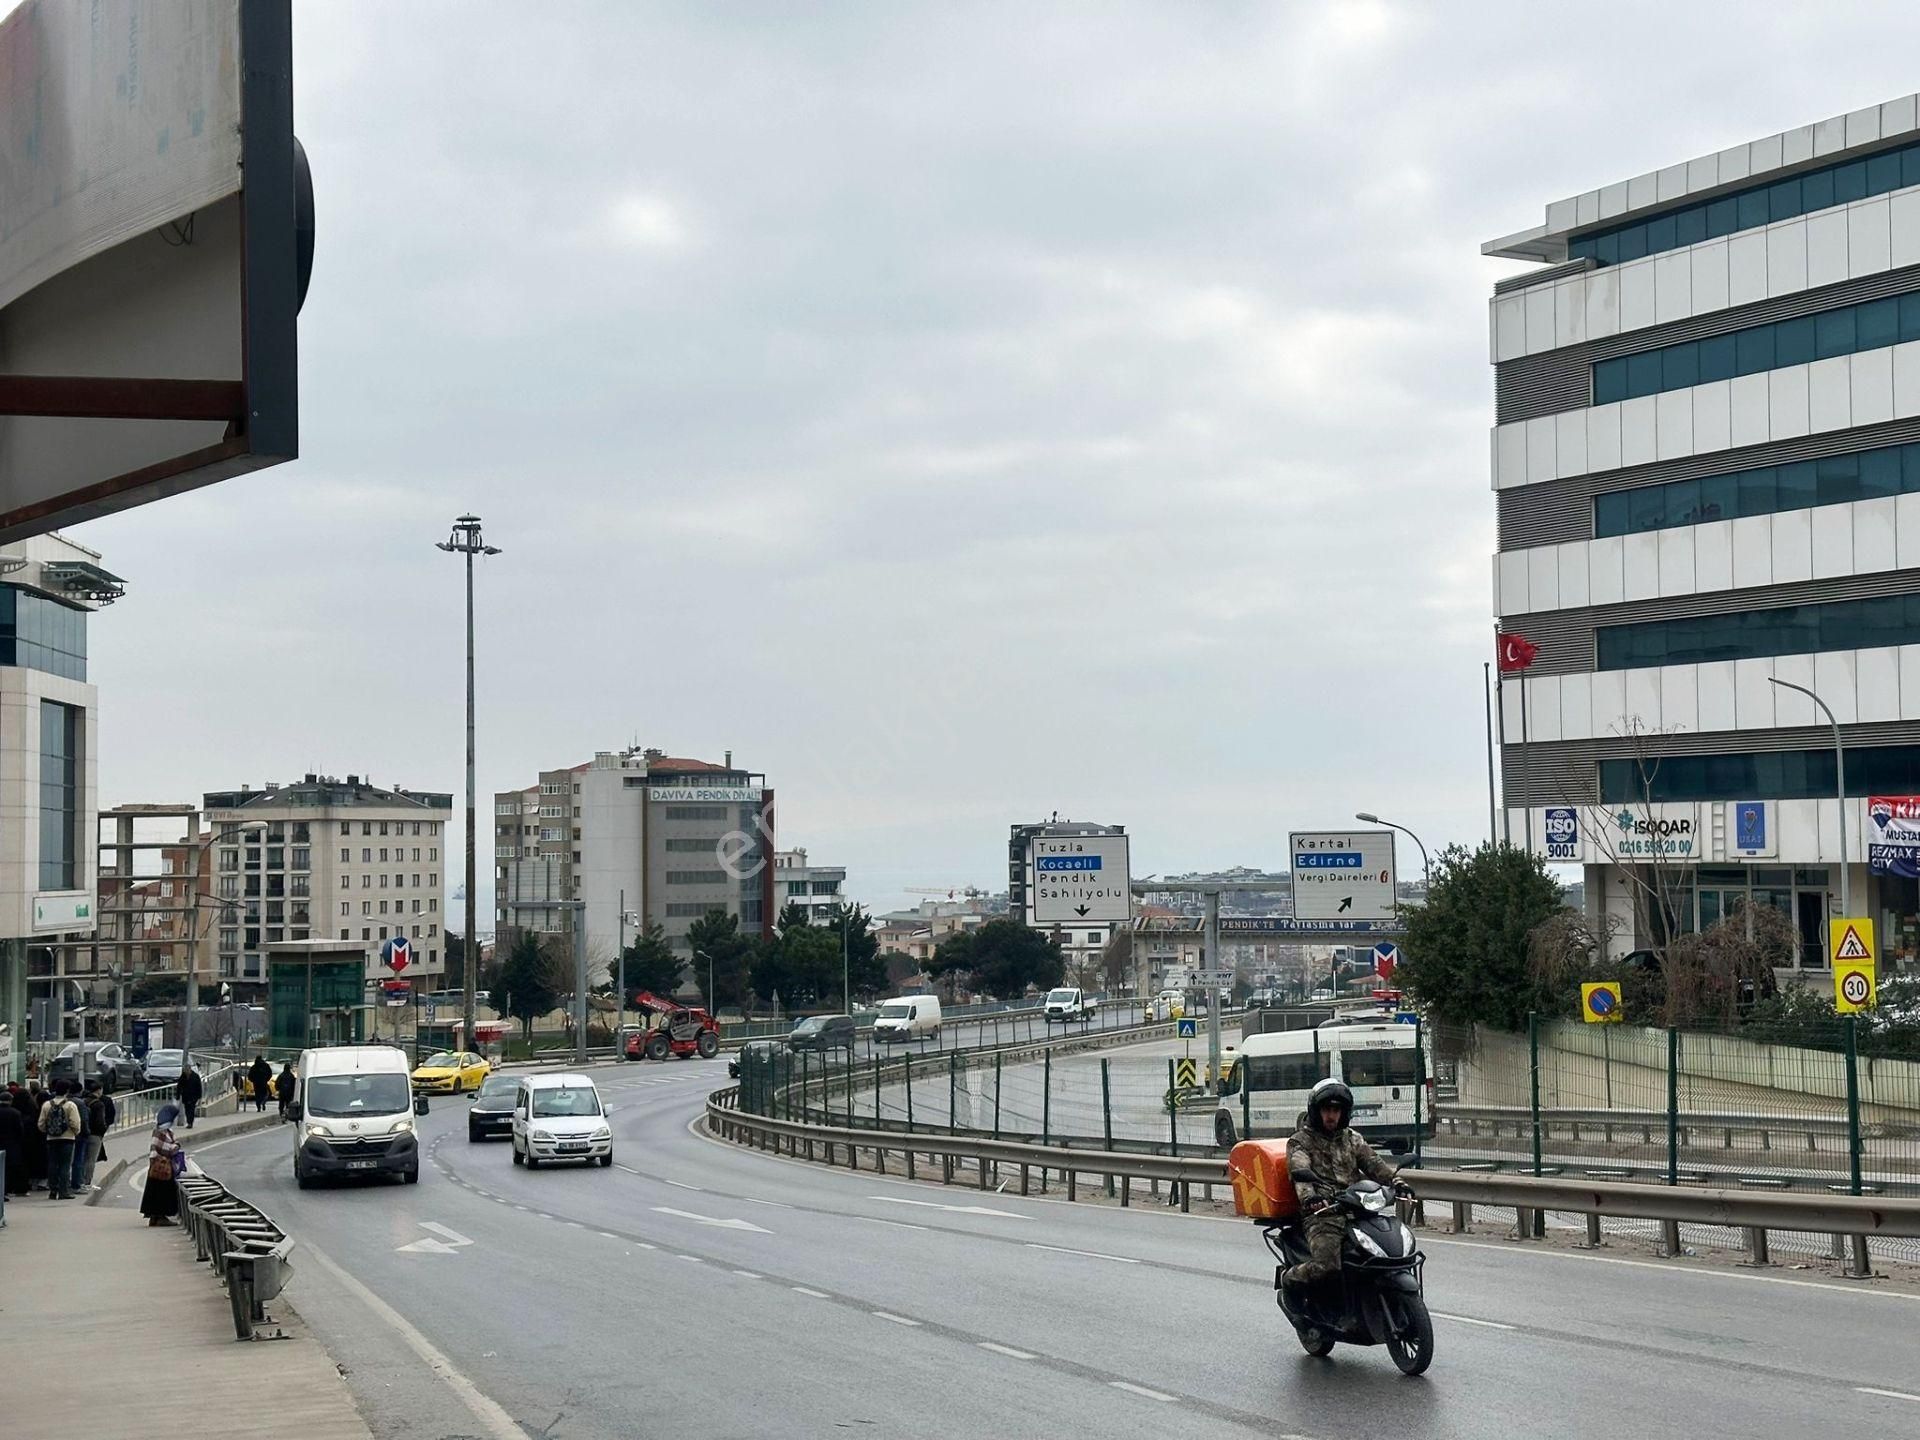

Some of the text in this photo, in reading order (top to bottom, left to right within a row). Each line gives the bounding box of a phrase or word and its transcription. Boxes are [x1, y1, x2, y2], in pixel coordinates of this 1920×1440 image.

[1546, 818, 1575, 834] ISO
[1634, 819, 1690, 837] ISOQAR
[1039, 842, 1083, 852] Tuzla
[1297, 838, 1352, 849] Kartal
[1619, 840, 1643, 854] 0216
[1664, 840, 1676, 853] 20
[1678, 839, 1691, 853] 00
[1548, 844, 1576, 857] 9001
[1871, 846, 1912, 859] RE/MAX
[1039, 858, 1092, 869] Kocaeli
[1298, 855, 1356, 866] Edirne
[1872, 858, 1893, 869] CITY
[1039, 873, 1097, 883] Pendik
[1040, 888, 1121, 900] Sahilyolu
[1847, 980, 1864, 996] 30
